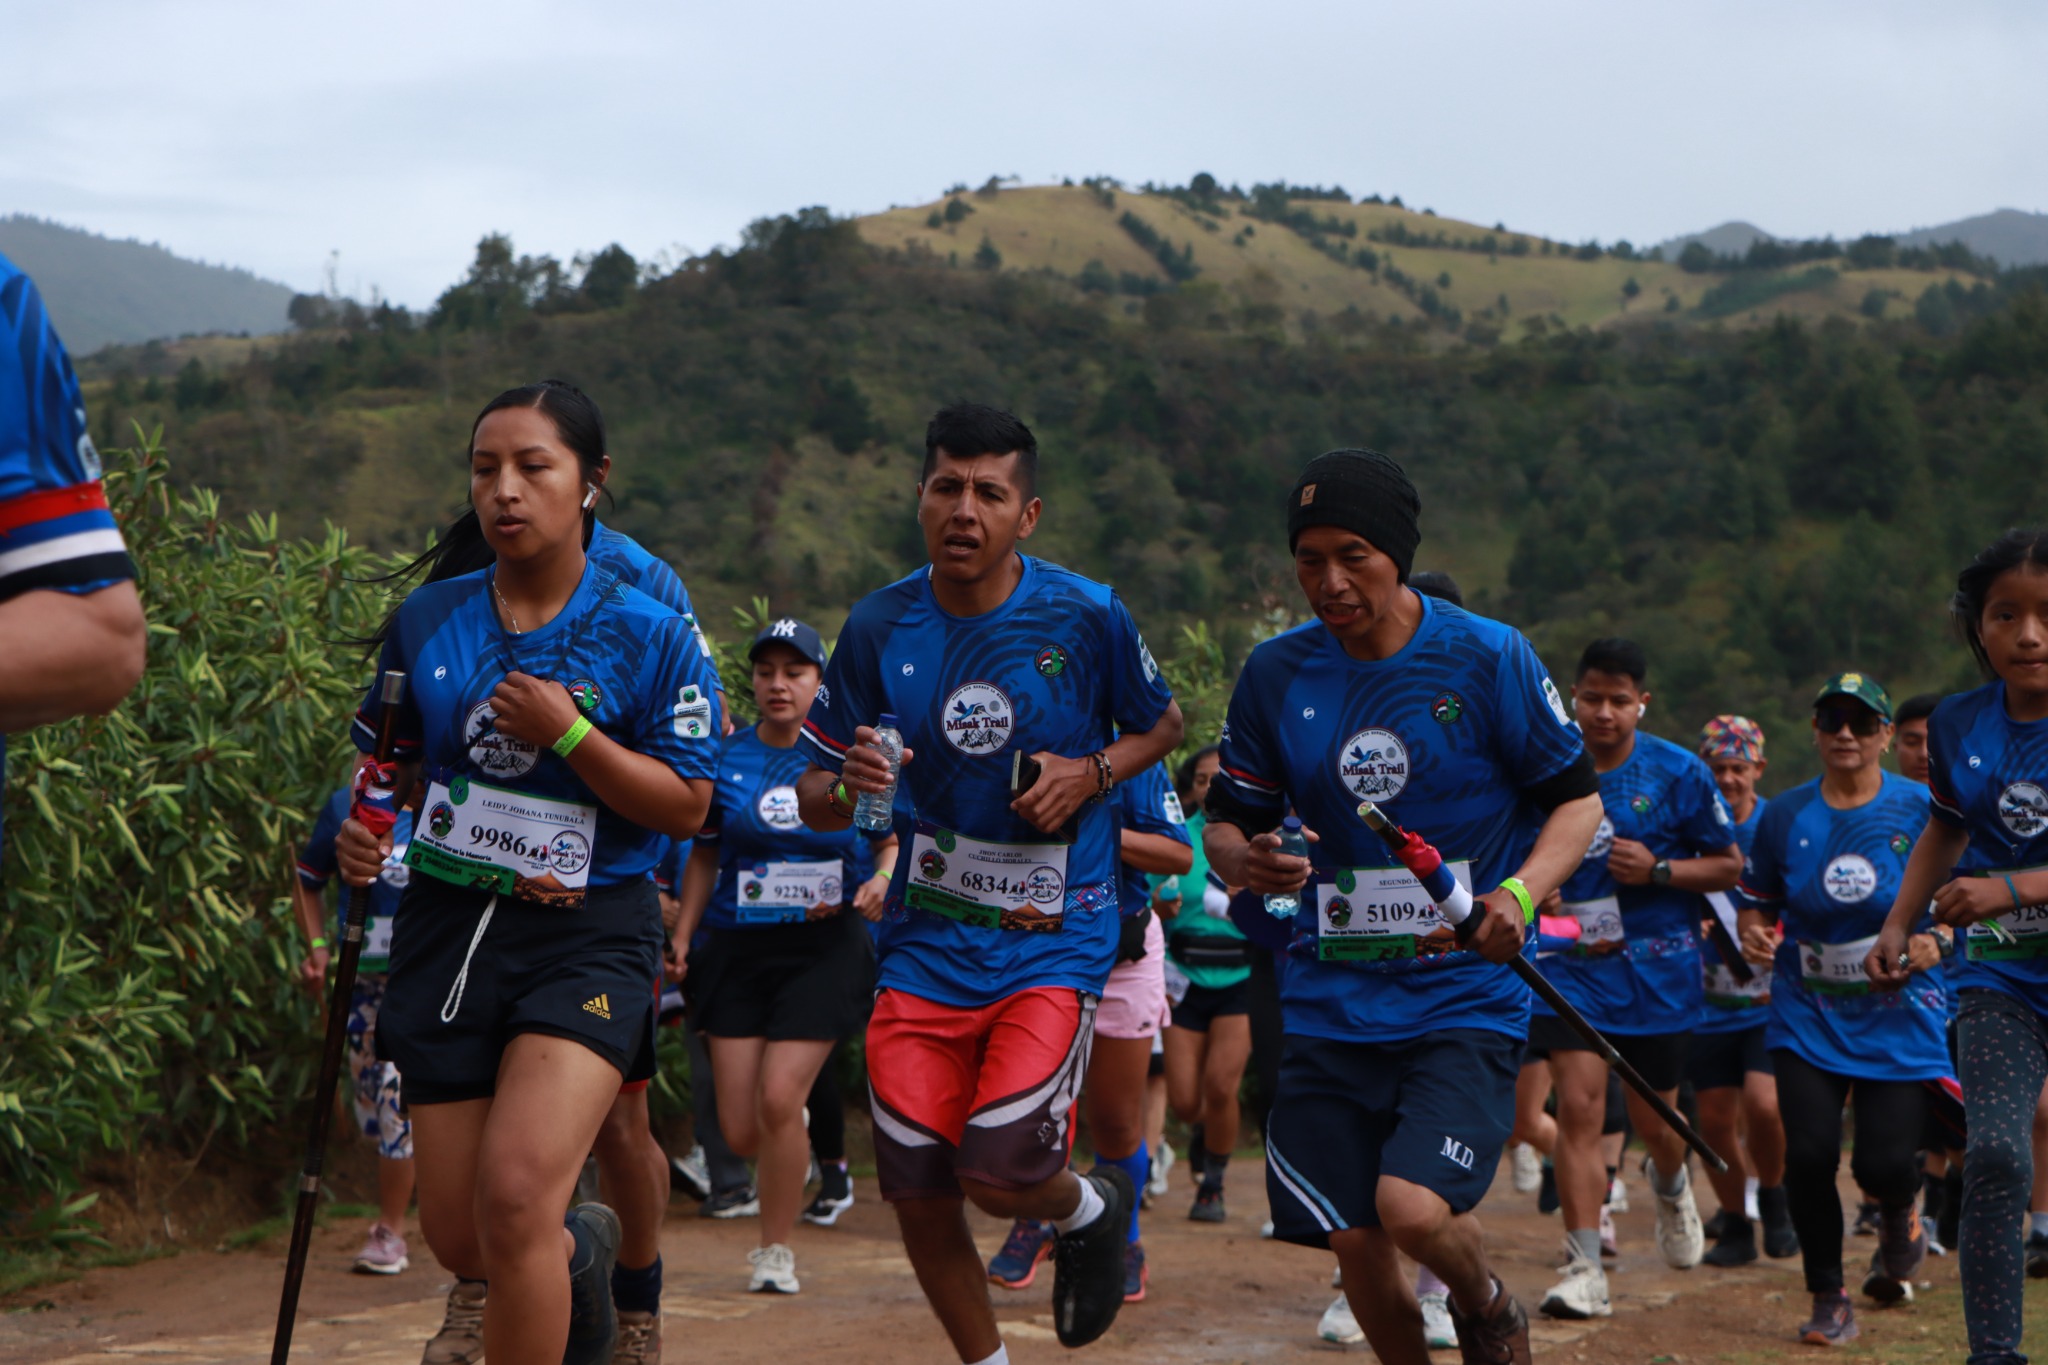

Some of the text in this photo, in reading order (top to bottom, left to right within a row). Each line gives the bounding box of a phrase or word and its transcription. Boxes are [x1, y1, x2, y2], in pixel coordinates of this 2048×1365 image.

[946, 716, 1009, 731] Misak Trail
[504, 738, 536, 753] Trail
[1342, 762, 1405, 776] Misak Trail
[481, 799, 585, 825] LEIDY JOHANA TUNUBALA
[468, 824, 529, 856] 9986
[466, 850, 492, 862] Memoria
[978, 849, 997, 857] JHON
[960, 871, 1008, 894] 6834
[1379, 878, 1412, 886] SEGUNDO
[774, 885, 808, 899] 9229
[1367, 902, 1415, 923] 5109
[583, 1003, 611, 1020] adidas
